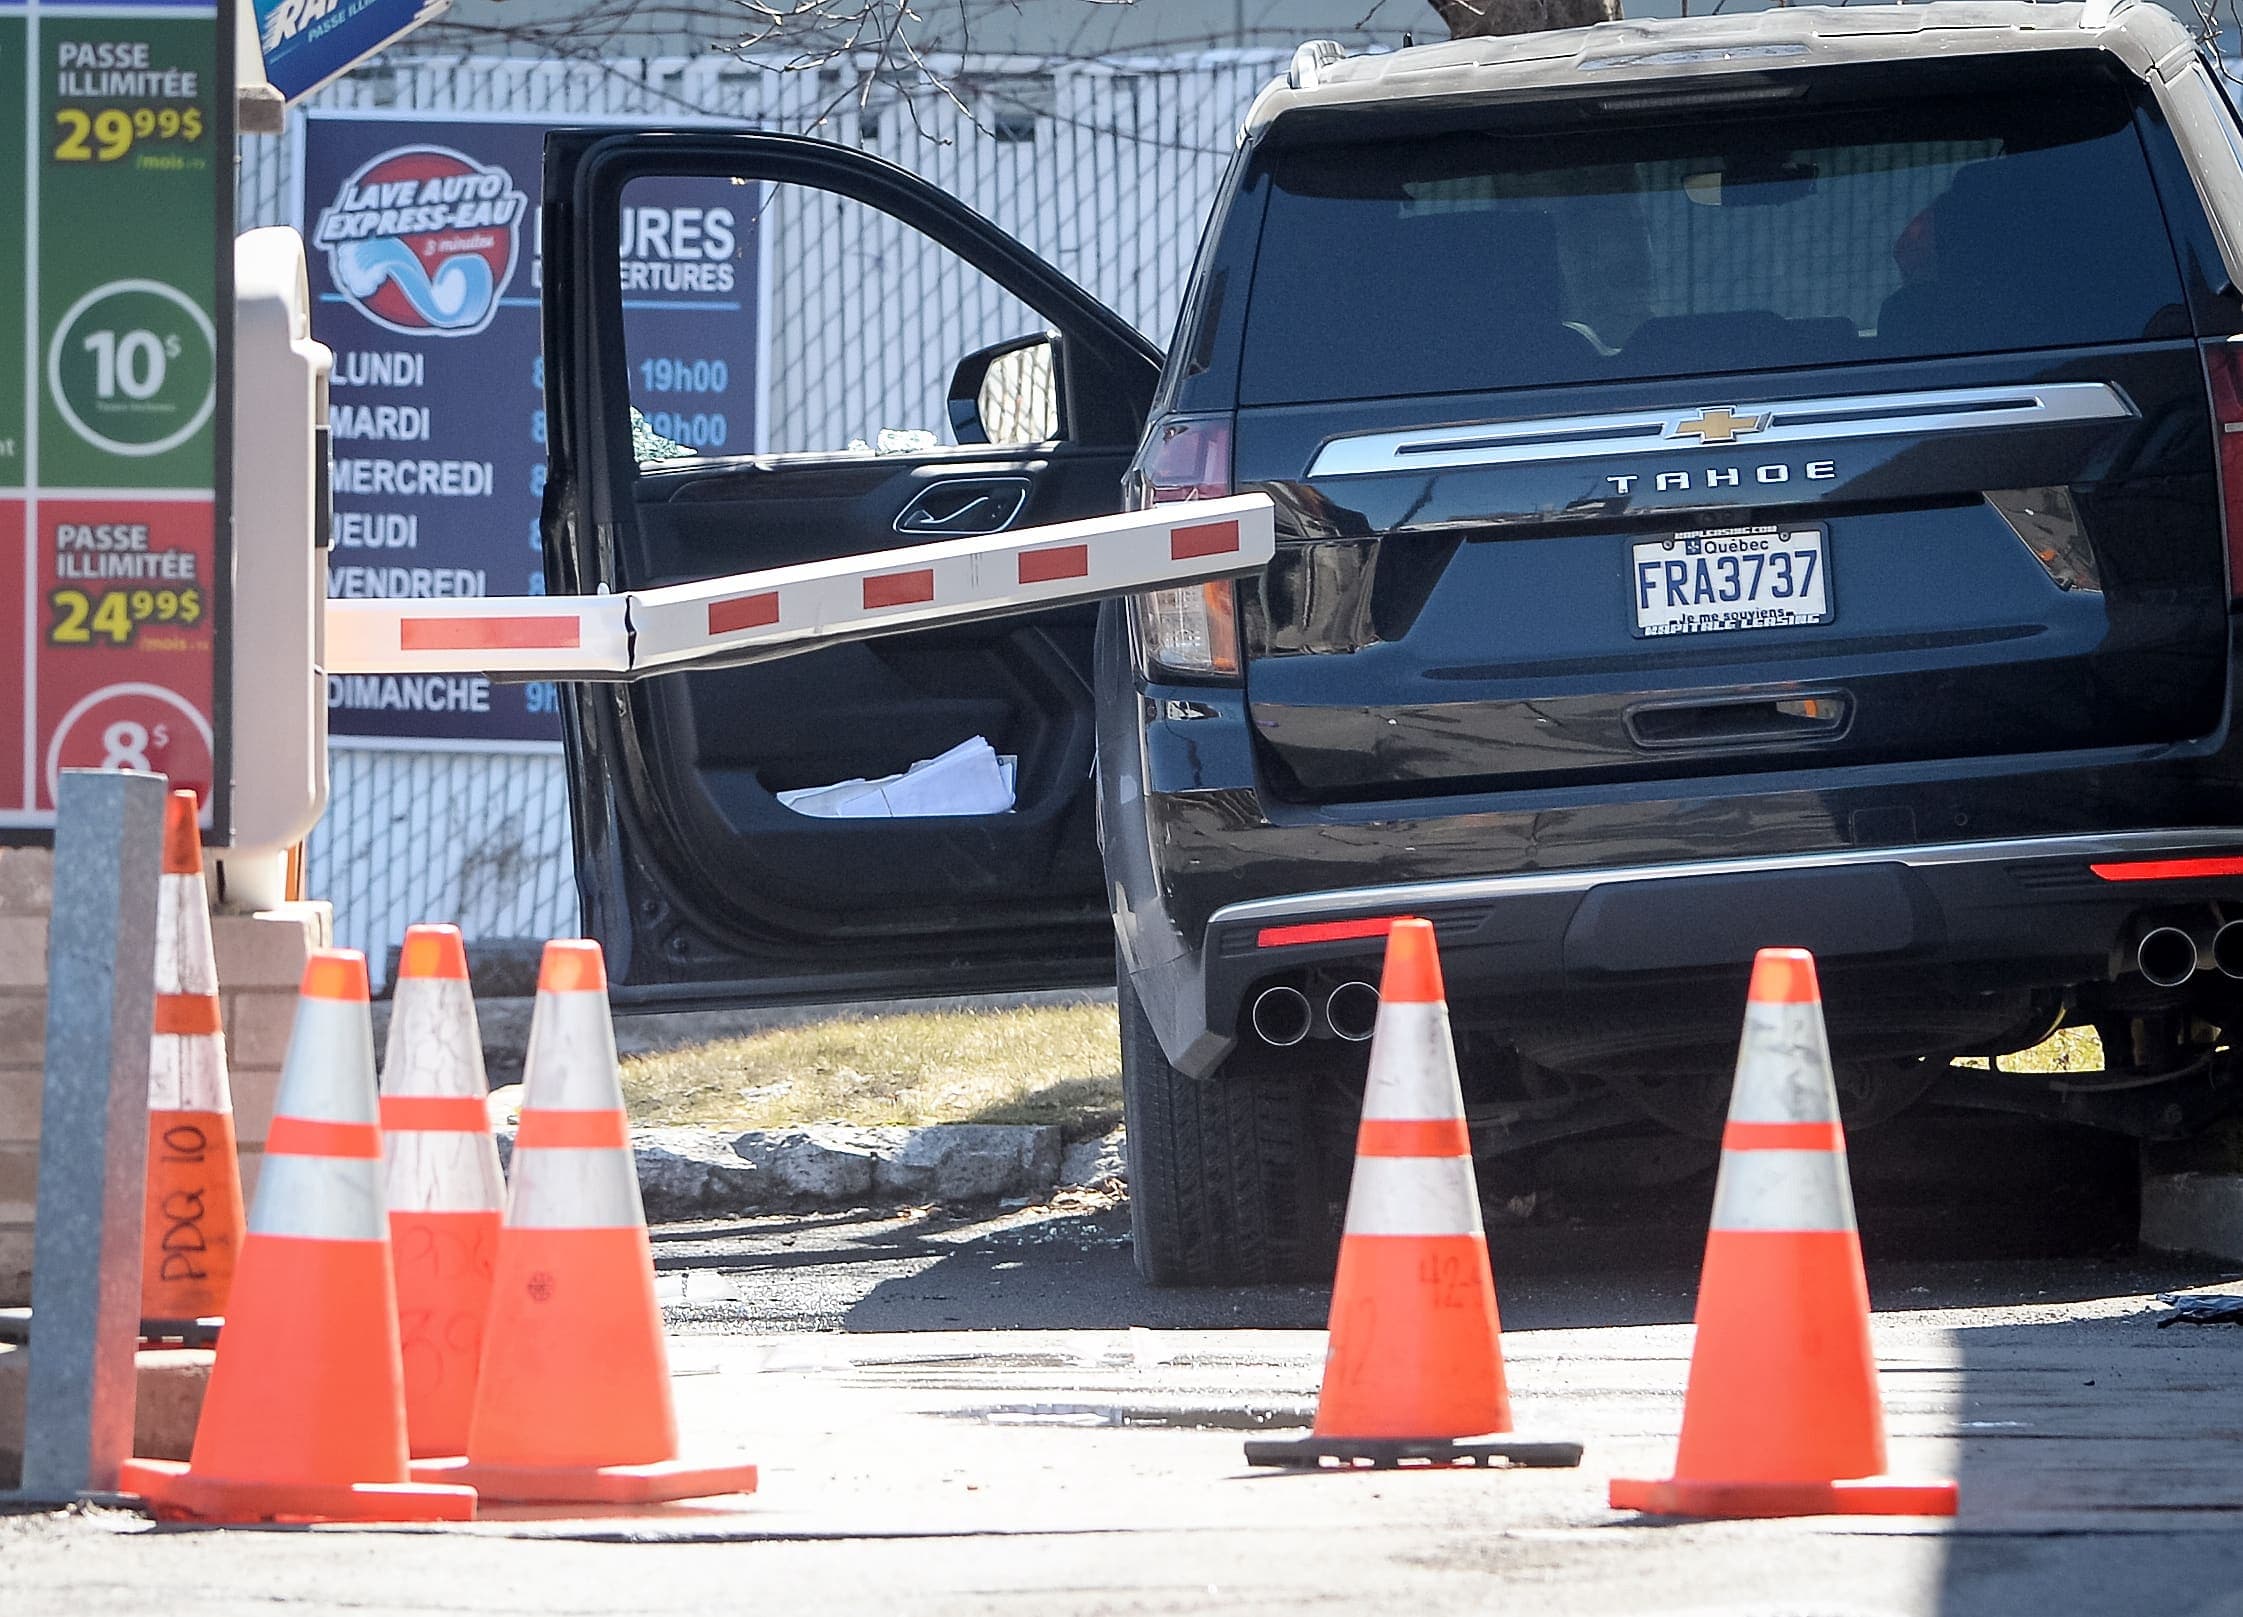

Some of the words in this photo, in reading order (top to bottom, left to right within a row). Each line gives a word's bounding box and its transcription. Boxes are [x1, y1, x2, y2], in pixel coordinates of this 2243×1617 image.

[308, 10, 346, 42] PASSE
[58, 42, 149, 69] PASSE
[58, 66, 198, 98] ILLIMITÉE
[344, 180, 420, 211] LAVE
[418, 174, 504, 205] AUTO
[321, 200, 518, 241] EXPRESS-EAU
[331, 351, 424, 387] LUNDI
[641, 358, 729, 393] 19h00
[330, 405, 430, 441] MARDI
[333, 458, 493, 496] MERCREDI
[1606, 460, 1836, 494] TAHOE
[56, 524, 149, 552] PASSE
[1704, 537, 1769, 555] Québec
[56, 549, 196, 580] ILLIMITÉE
[1638, 550, 1817, 609] FRA3737
[328, 566, 487, 598] VENDREDI
[1680, 611, 1696, 625] Je
[1700, 611, 1721, 623] me
[1724, 607, 1785, 622] souviens
[328, 674, 491, 713] DIMANCHE
